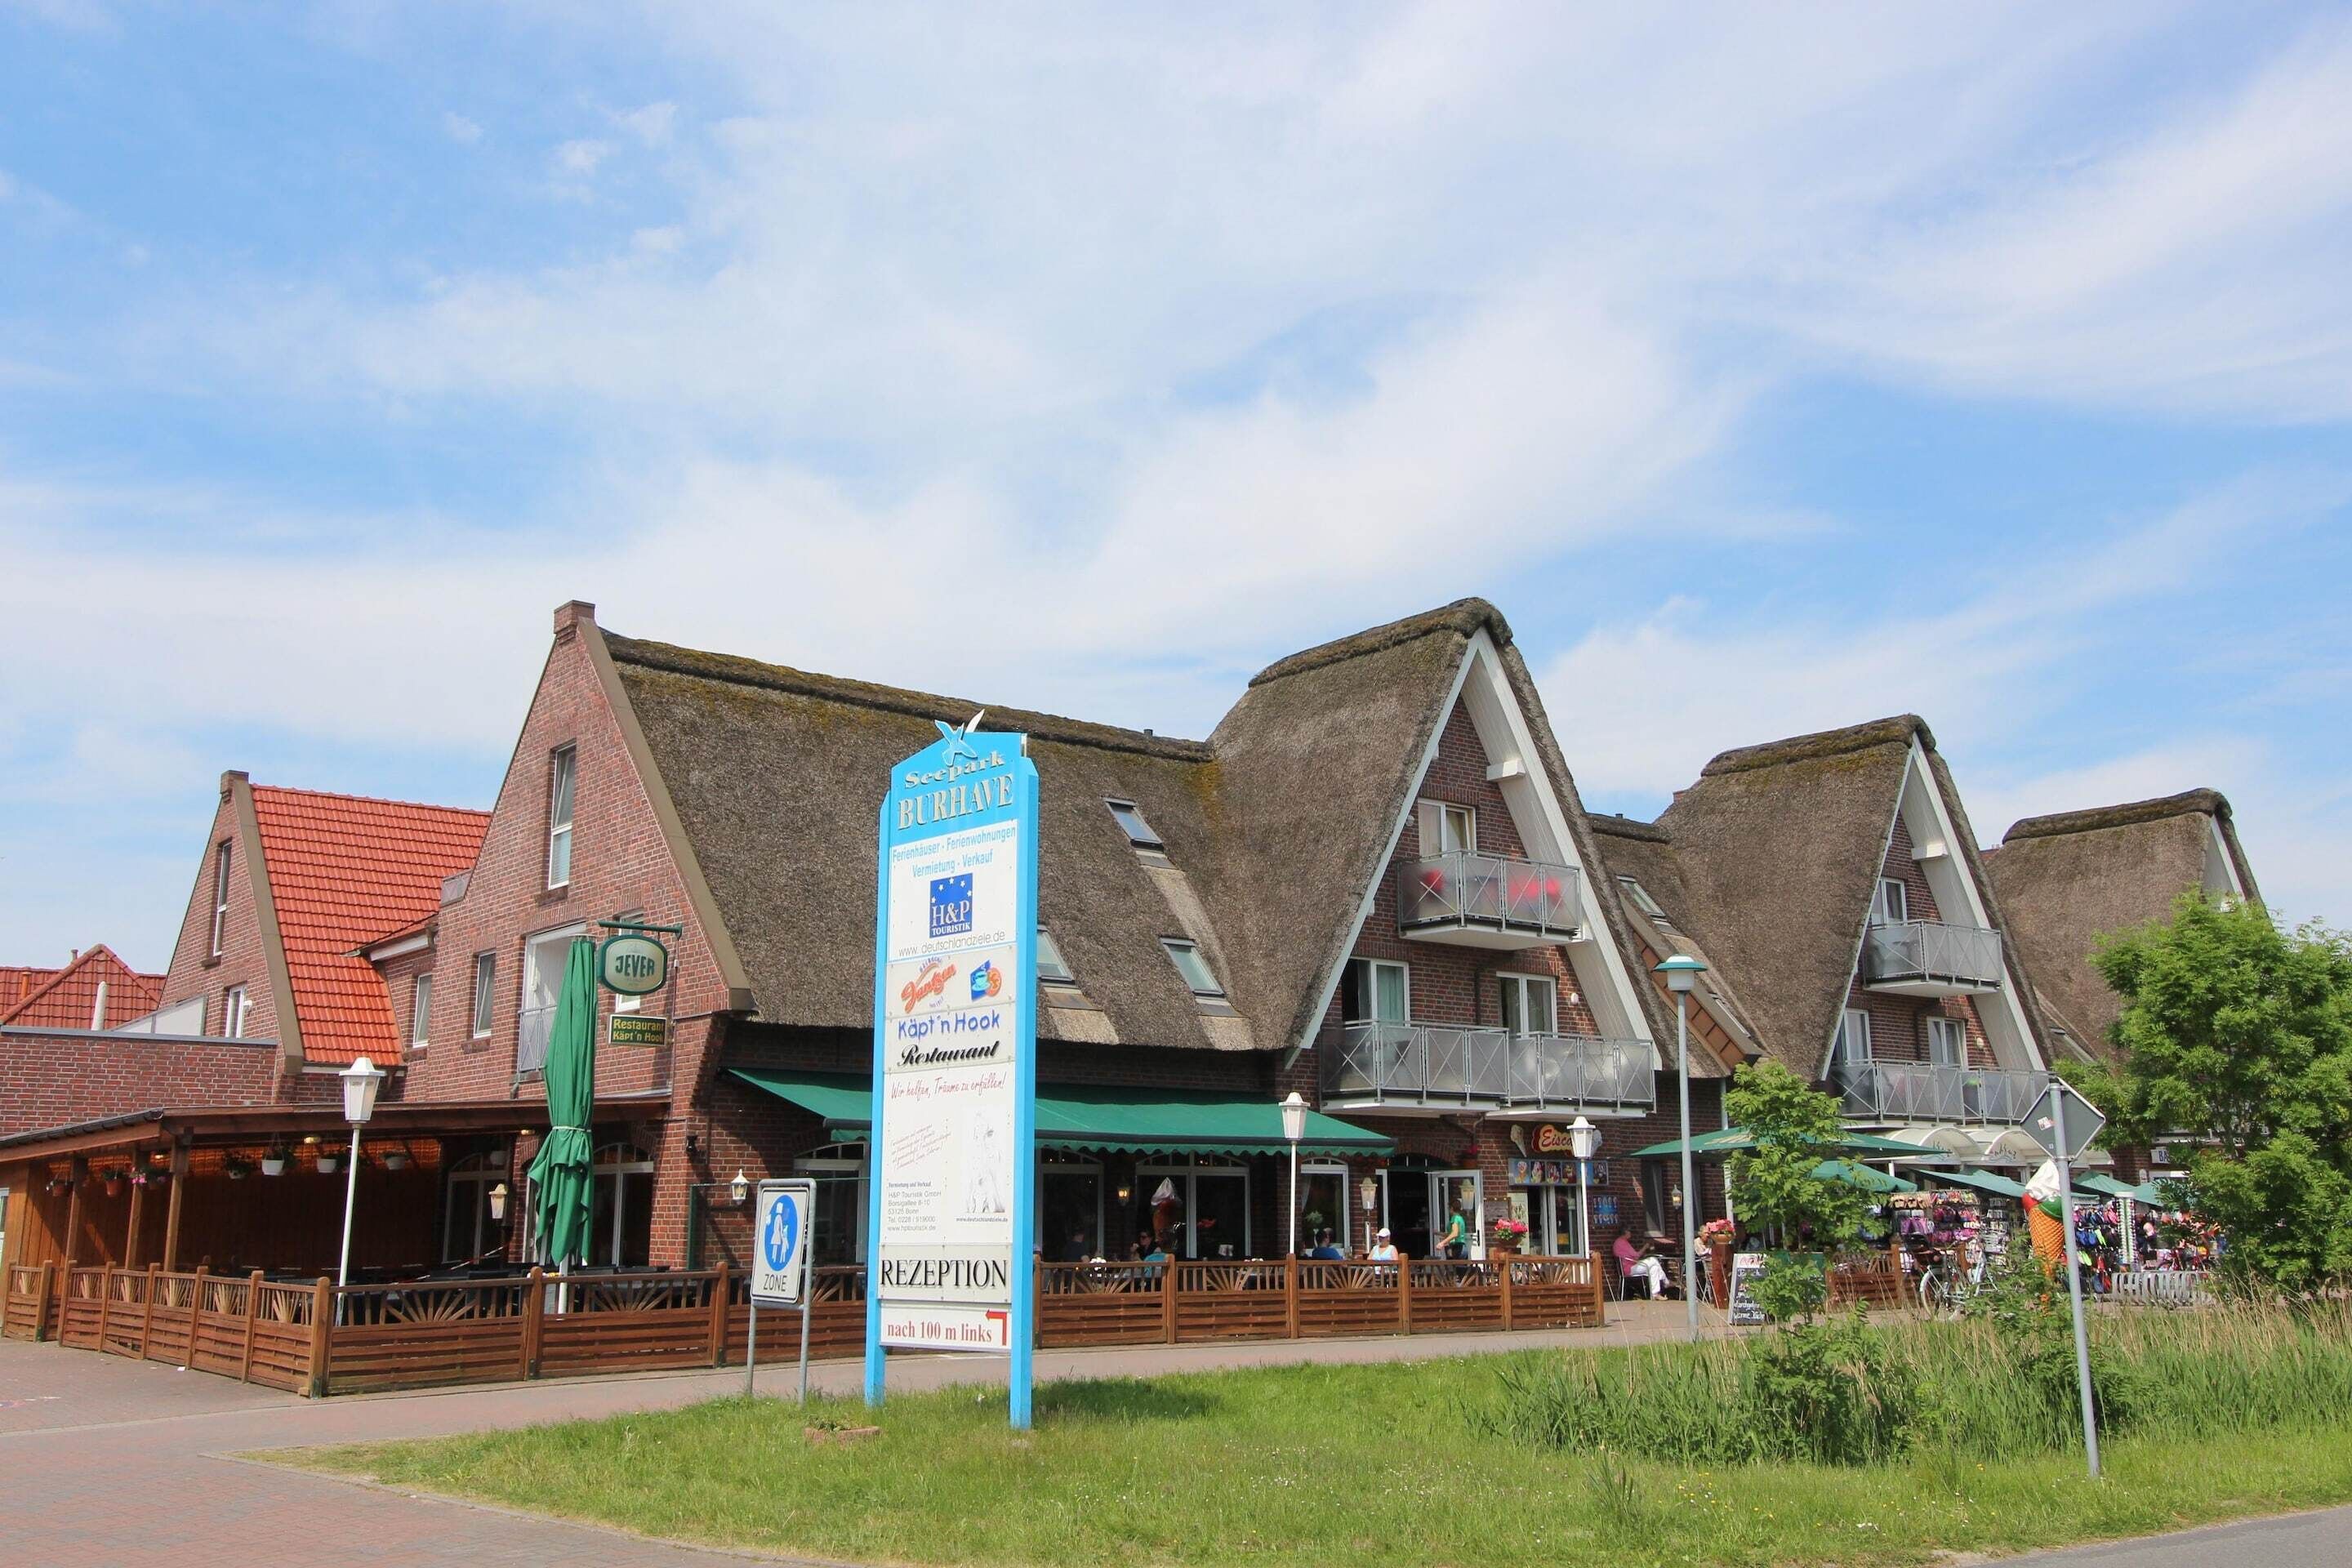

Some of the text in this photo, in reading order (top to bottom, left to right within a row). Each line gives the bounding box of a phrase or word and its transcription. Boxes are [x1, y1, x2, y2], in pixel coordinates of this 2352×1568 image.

[905, 751, 1005, 789] Seepark
[898, 774, 1013, 830] BURHAVE
[893, 844, 941, 862] Ferienhäuser
[947, 826, 1016, 850] Ferienwohnungen
[912, 860, 956, 878] Vermietung
[962, 849, 994, 867] Verkauf
[932, 900, 970, 928] H&P
[932, 922, 971, 936] TOURISTIK
[615, 955, 655, 978] JEVER
[955, 1009, 1000, 1033] Hook
[898, 1040, 1000, 1067] Restaurant
[891, 1081, 905, 1098] Wir
[934, 1076, 960, 1094] Träume
[763, 1274, 787, 1292] ZONE
[880, 1258, 1008, 1288] REZEPTION
[888, 1321, 992, 1343] nach 100 m links
